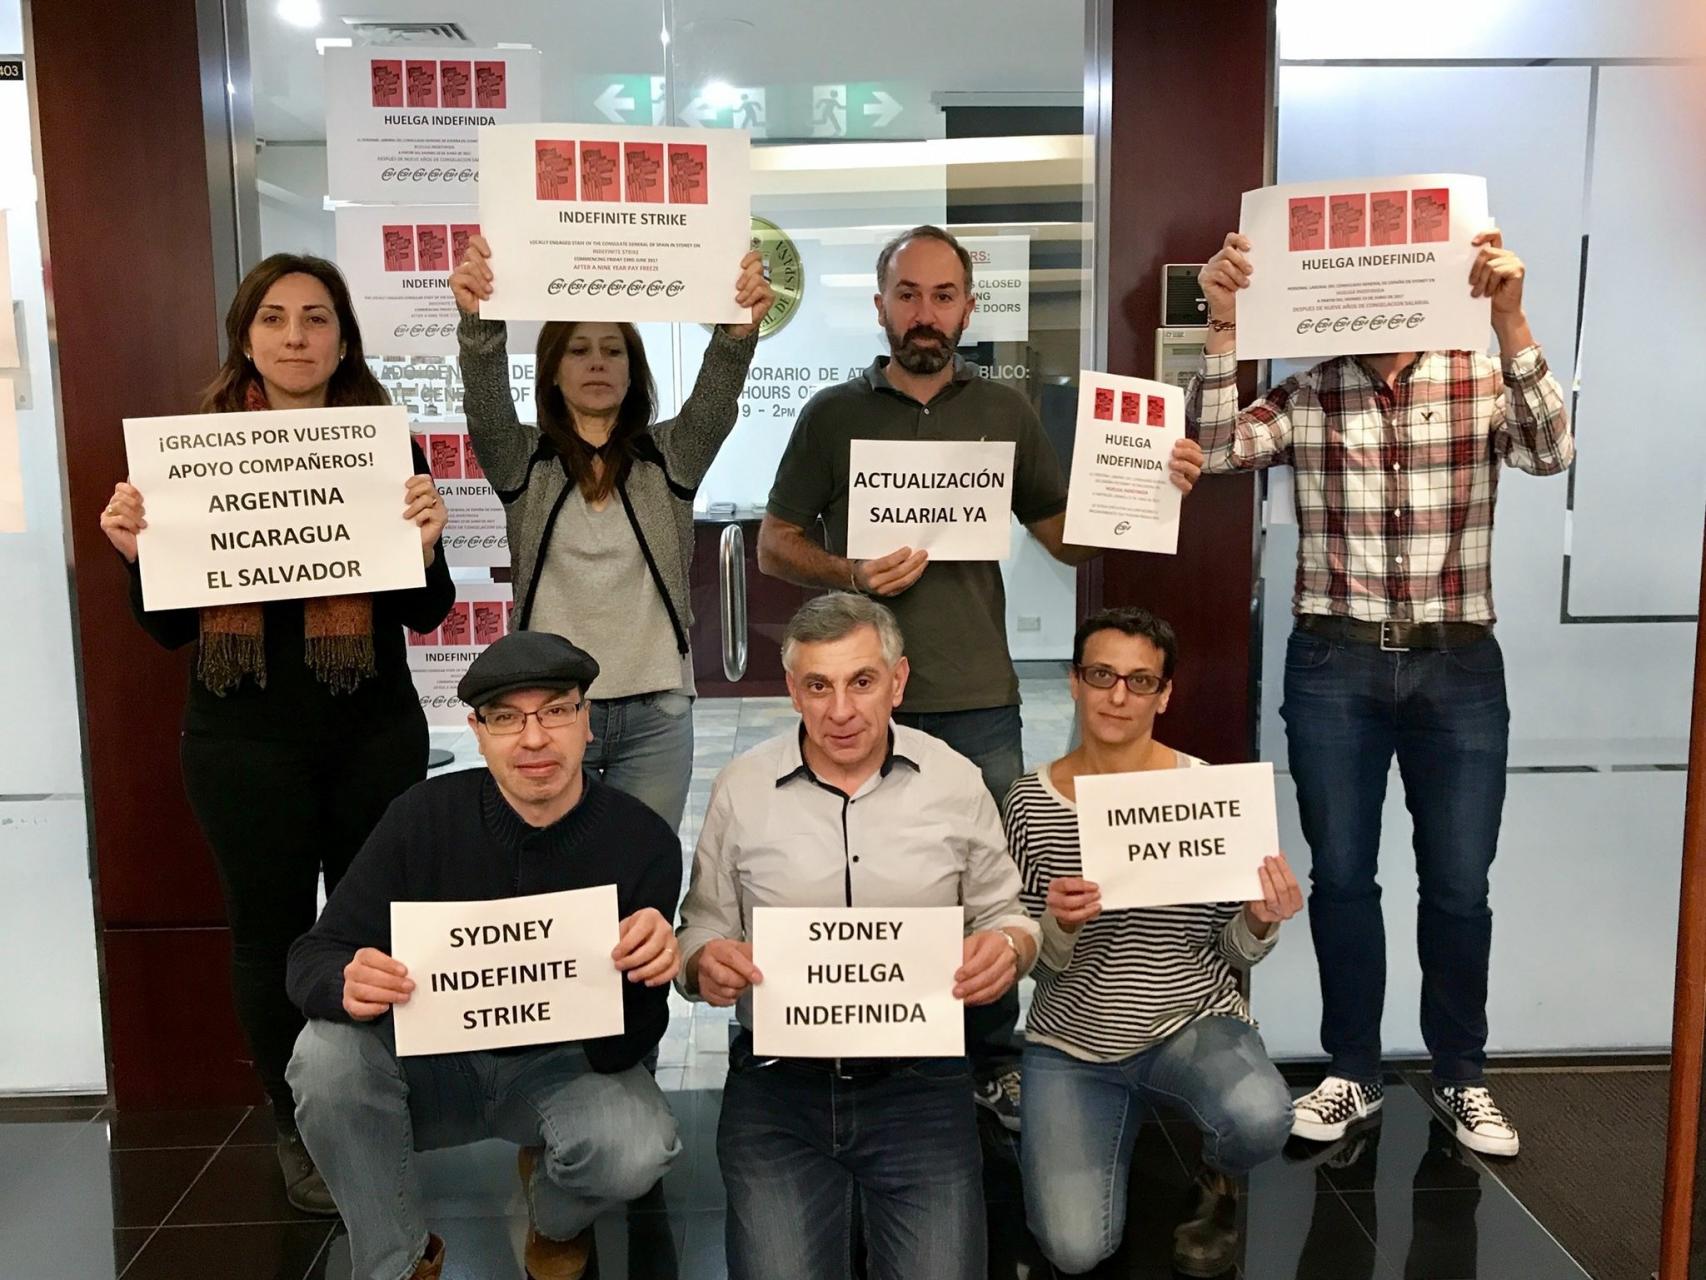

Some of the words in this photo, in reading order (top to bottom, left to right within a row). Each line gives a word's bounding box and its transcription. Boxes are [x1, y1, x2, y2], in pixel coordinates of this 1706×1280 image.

[384, 115, 429, 126] HUELGA
[432, 115, 496, 126] INDEFINIDA
[559, 211, 637, 225] INDEFINITE
[641, 213, 687, 226] STRIKE
[1302, 256, 1355, 270] HUELGA
[1358, 251, 1436, 267] INDEFINIDA
[402, 279, 450, 289] INDEFINI
[978, 279, 1022, 289] CLOSED
[983, 303, 1021, 313] DOORS
[512, 364, 535, 380] DE
[818, 367, 840, 381] DE
[979, 364, 1031, 379] BLICO:
[510, 387, 531, 402] OF
[741, 386, 791, 400] HOURS
[158, 431, 246, 452] ¡GRACIAS
[252, 428, 289, 445] POR
[294, 424, 377, 443] VUESTRO
[1105, 434, 1152, 449] HUELGA
[168, 461, 233, 480] APOYO
[239, 452, 374, 475] COMPAÑEROS!
[1096, 453, 1163, 471] INDEFINIDA
[853, 468, 1005, 489] ACTUALIZACIÓN
[208, 487, 344, 513] ARGENTINA
[456, 486, 494, 496] INDEFI
[870, 507, 957, 523] SALARIAL
[963, 506, 987, 522] YA
[210, 523, 350, 551] NICARAGUA
[207, 570, 232, 589] EL
[238, 560, 362, 587] SALVADOR
[425, 652, 480, 662] INDEFINIT
[1107, 800, 1241, 827] IMMEDIATE
[1128, 841, 1171, 861] PAY
[1179, 837, 1226, 858] RISE
[450, 918, 554, 947] SYDNEY
[809, 921, 903, 941] SYDNEY
[431, 959, 577, 992] INDEFINITE
[807, 963, 905, 984] HUELGA
[463, 1001, 551, 1030] STRIKE
[786, 1003, 927, 1025] INDEFINIDA
